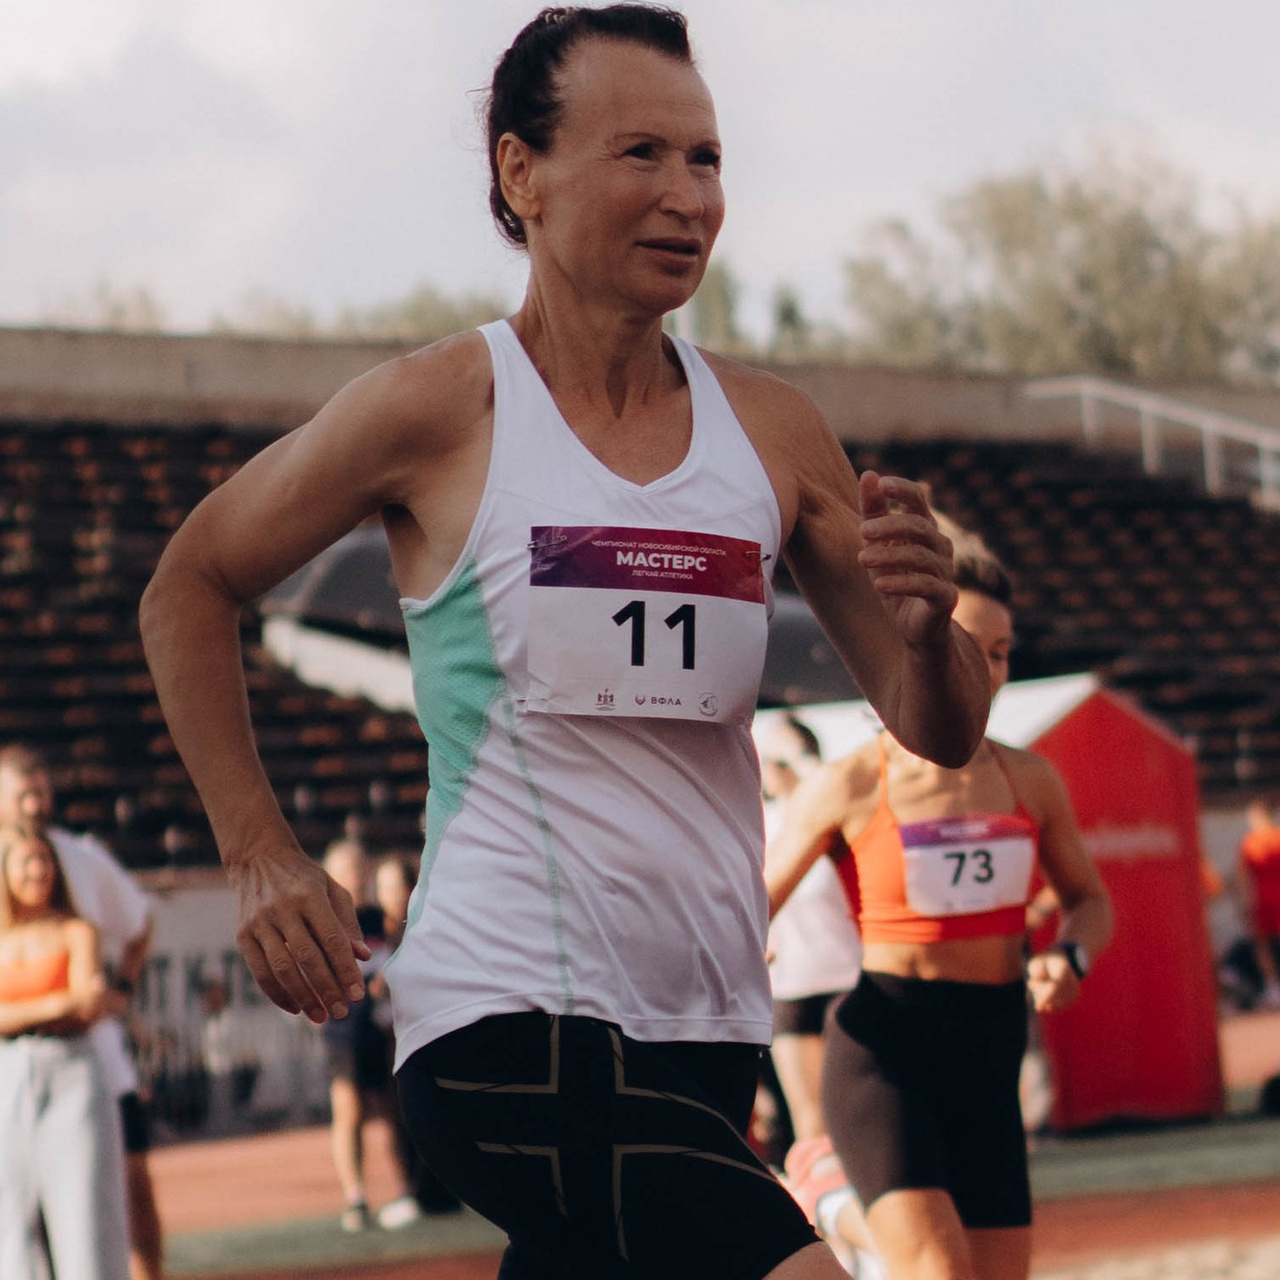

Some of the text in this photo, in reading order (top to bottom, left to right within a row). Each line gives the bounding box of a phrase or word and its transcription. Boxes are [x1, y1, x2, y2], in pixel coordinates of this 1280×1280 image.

[616, 550, 707, 572] МАСТЕРС
[611, 600, 696, 670] 11
[650, 696, 682, 706] ВФЛА
[943, 848, 995, 886] 73
